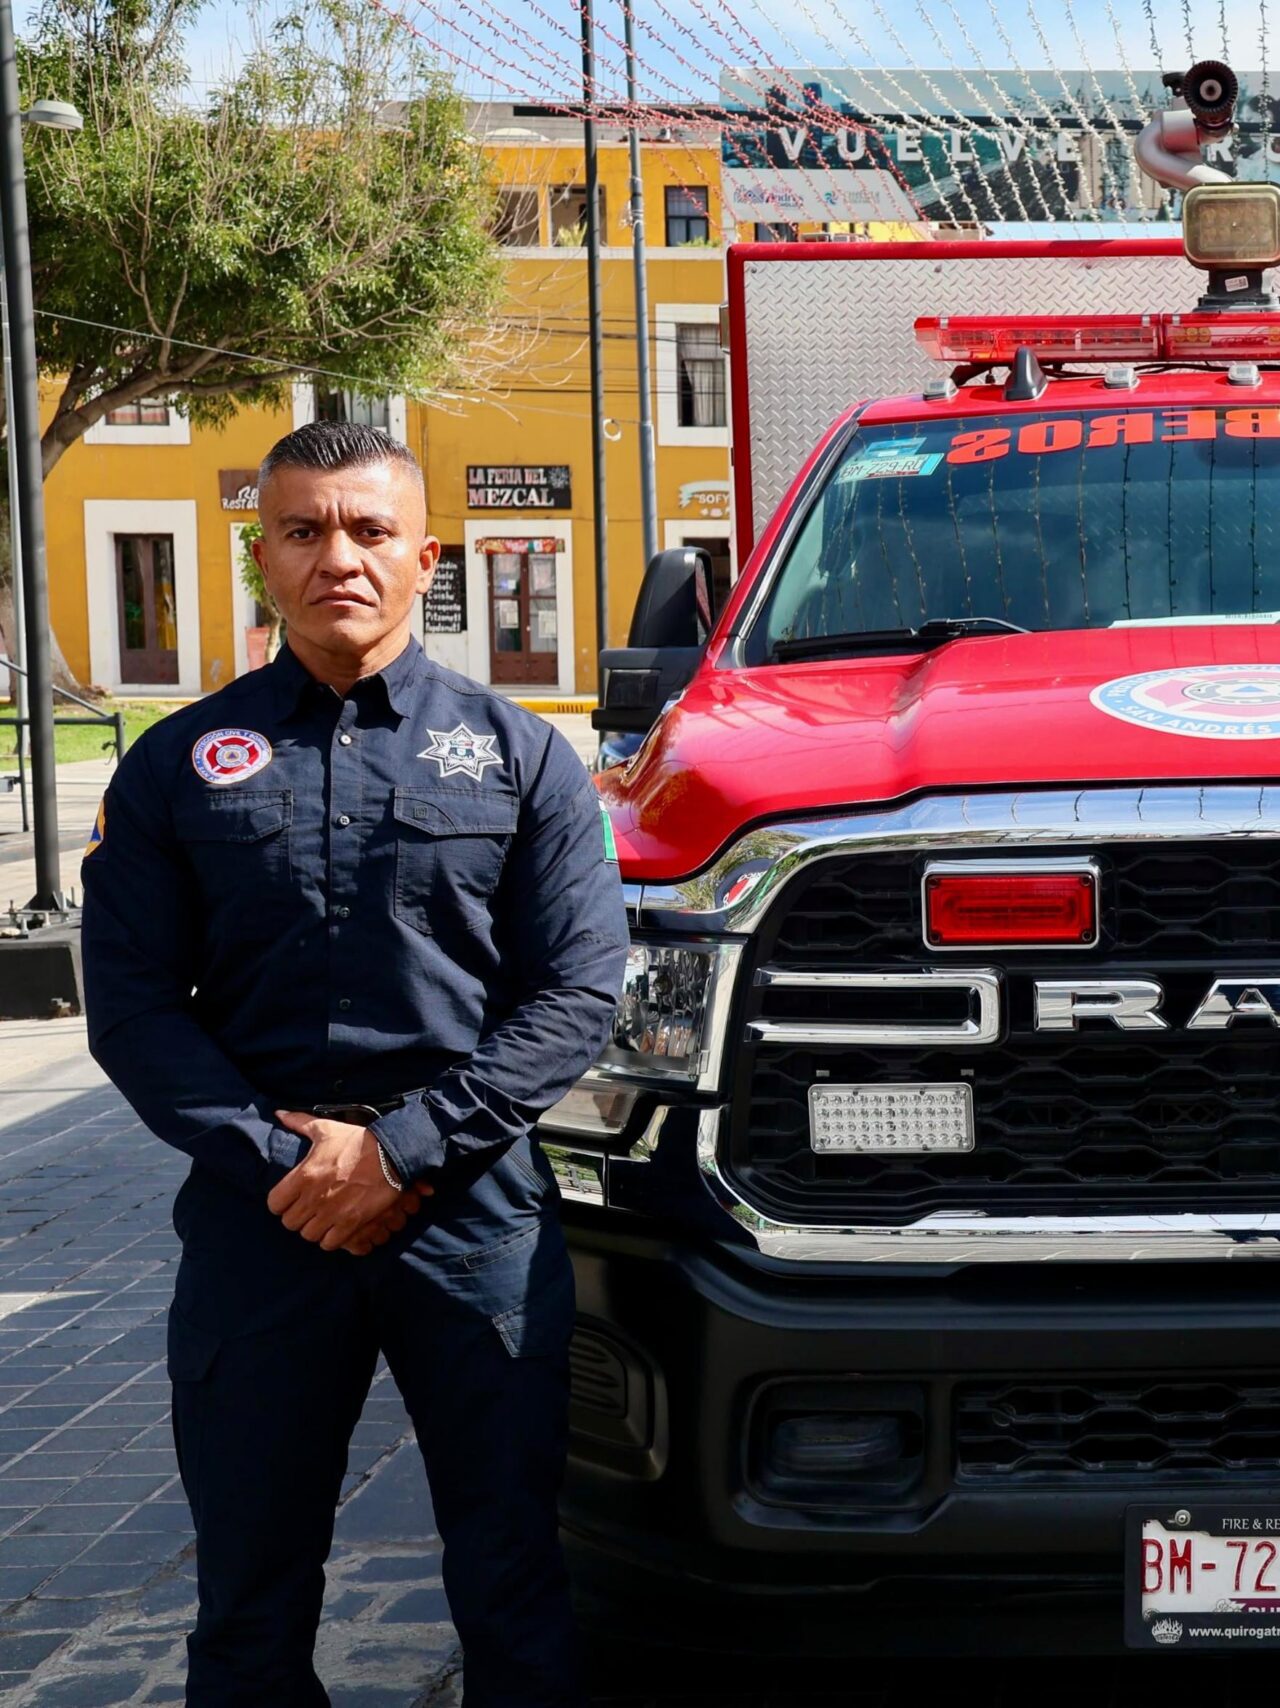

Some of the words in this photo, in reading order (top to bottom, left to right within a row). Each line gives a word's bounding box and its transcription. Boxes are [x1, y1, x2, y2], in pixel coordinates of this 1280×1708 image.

[778, 126, 1082, 162] VUELVE
[468, 468, 485, 485] LA
[487, 468, 522, 485] FERIA
[524, 468, 547, 485] DEL
[468, 488, 554, 507] MEZCAL
[1119, 705, 1163, 723] SAN
[1165, 717, 1273, 735] ANDRÉS
[1222, 1518, 1250, 1530] FIRE
[1252, 1519, 1263, 1530] &
